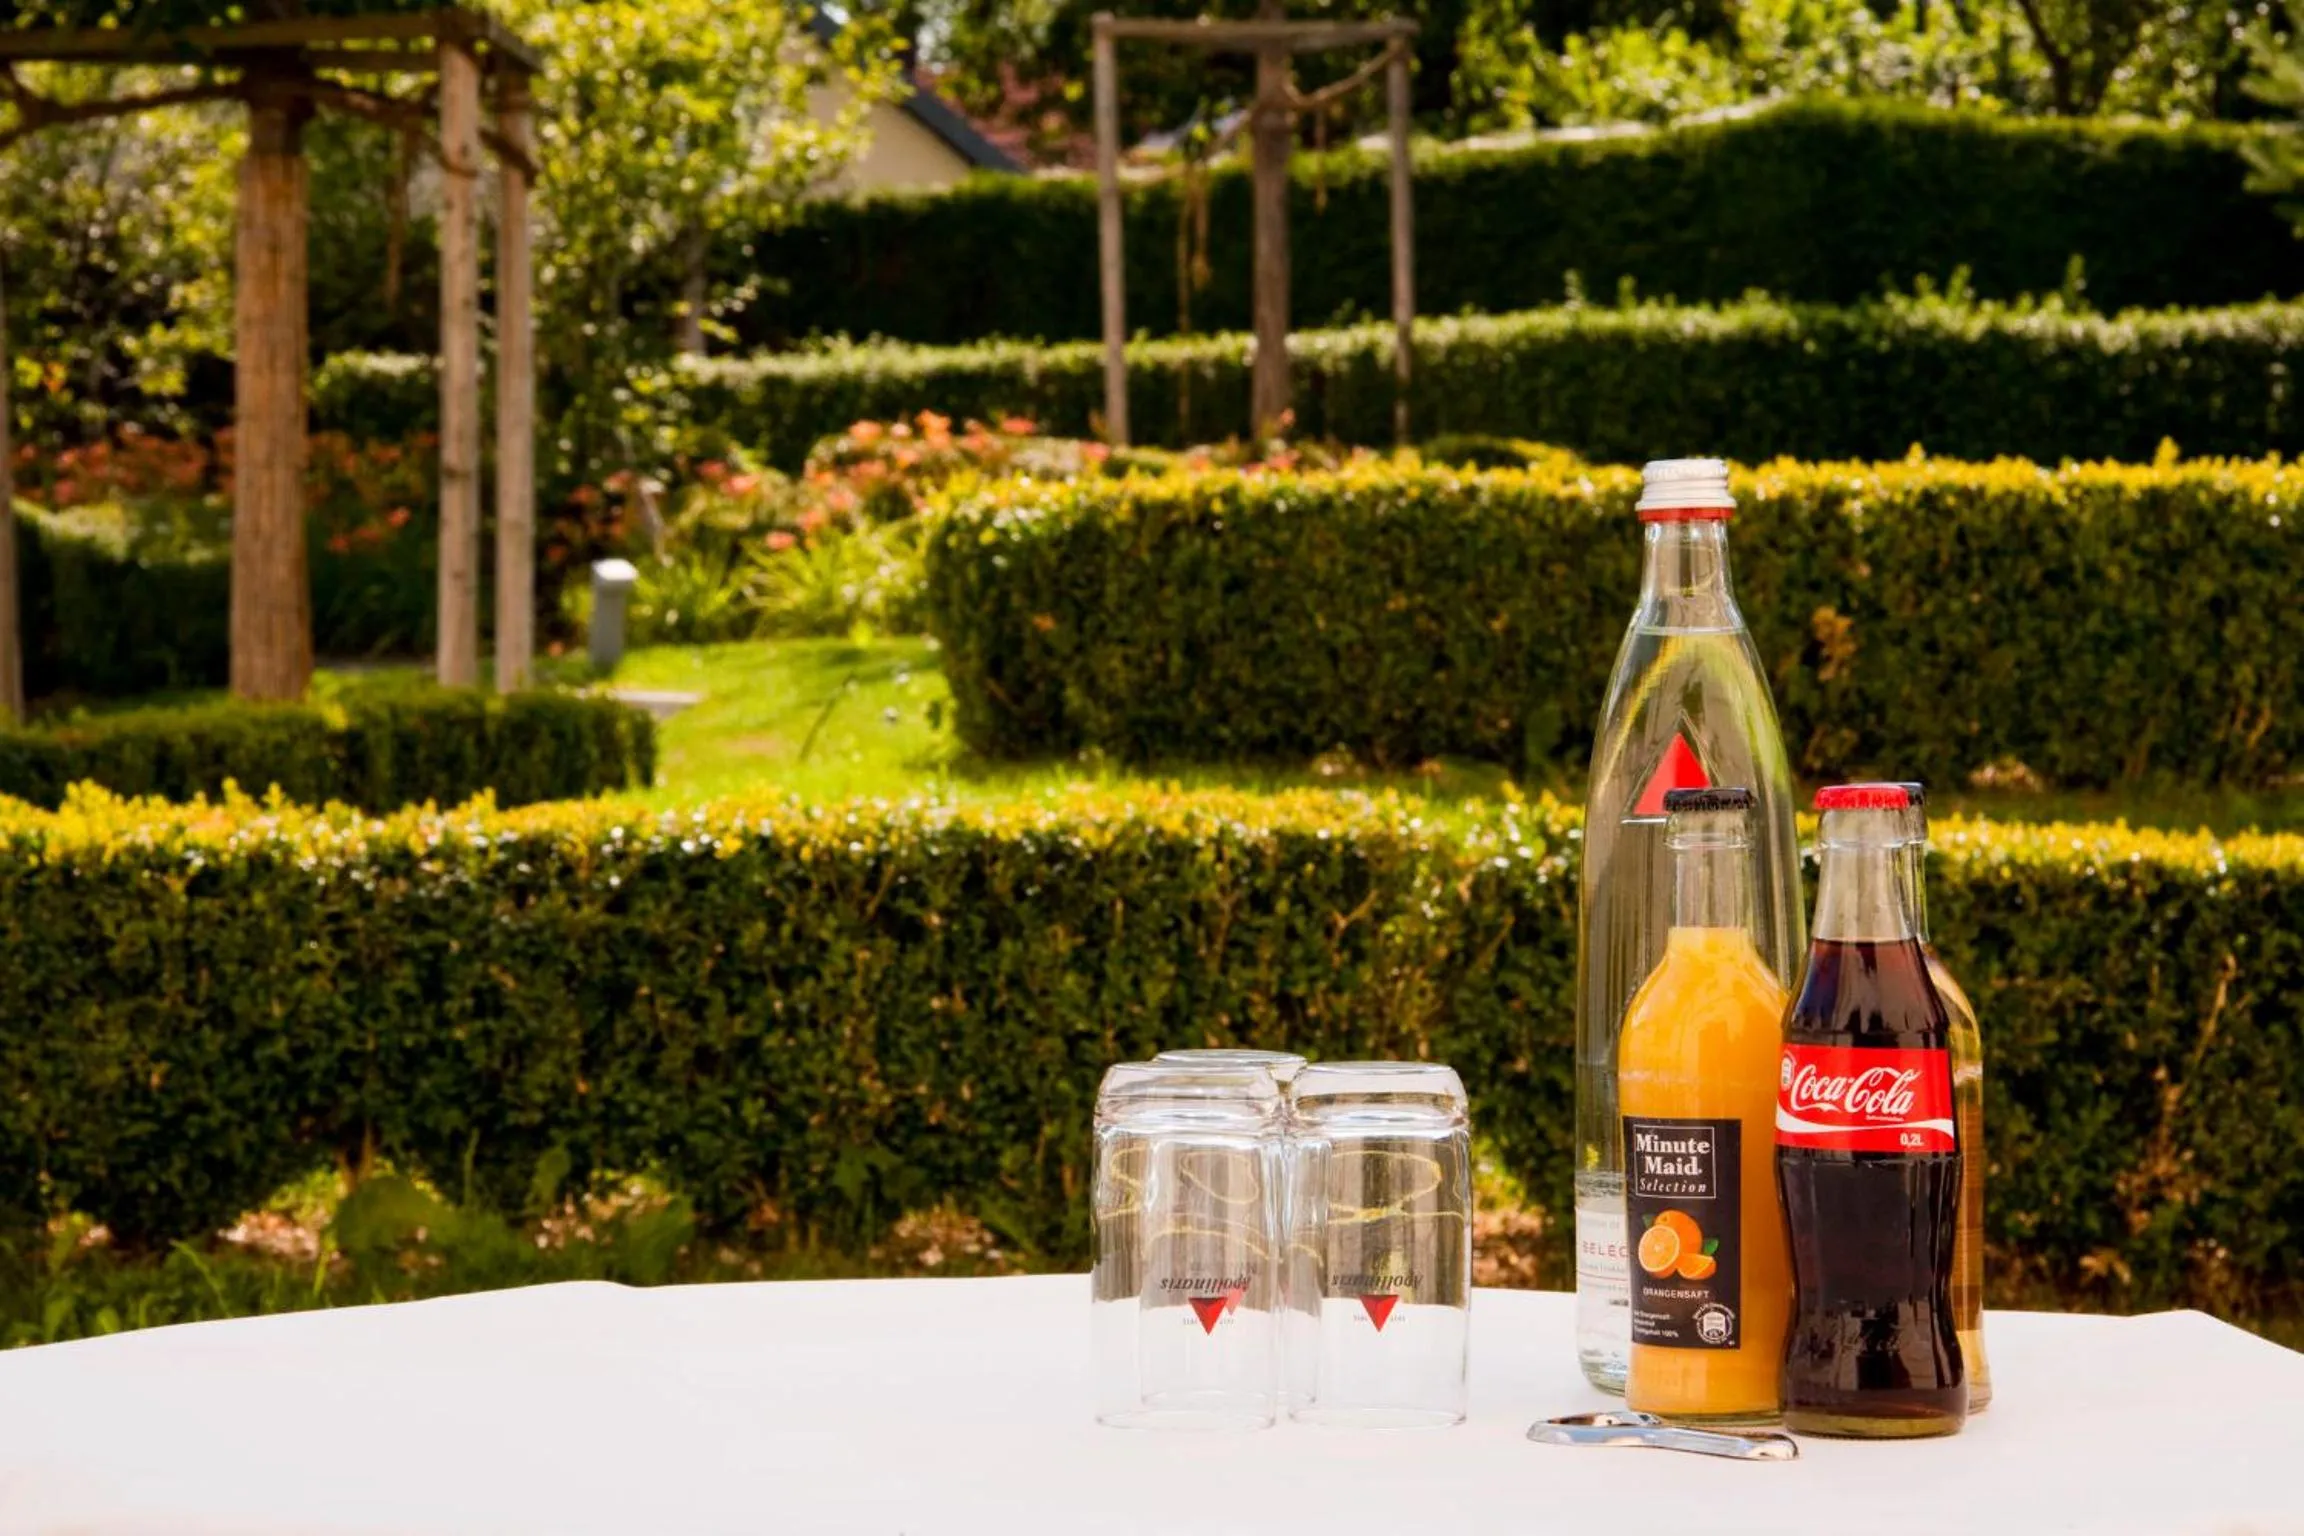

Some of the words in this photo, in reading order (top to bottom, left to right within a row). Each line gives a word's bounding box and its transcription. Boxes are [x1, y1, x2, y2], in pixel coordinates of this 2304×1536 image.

[1791, 1064, 1922, 1114] Coca-Cola
[1636, 1133, 1711, 1154] Minute
[1640, 1178, 1707, 1193] Selection
[1160, 1274, 1252, 1293] Apollinaris
[1331, 1270, 1424, 1290] Apollinaris
[1642, 1287, 1711, 1299] ORANGENSAFT
